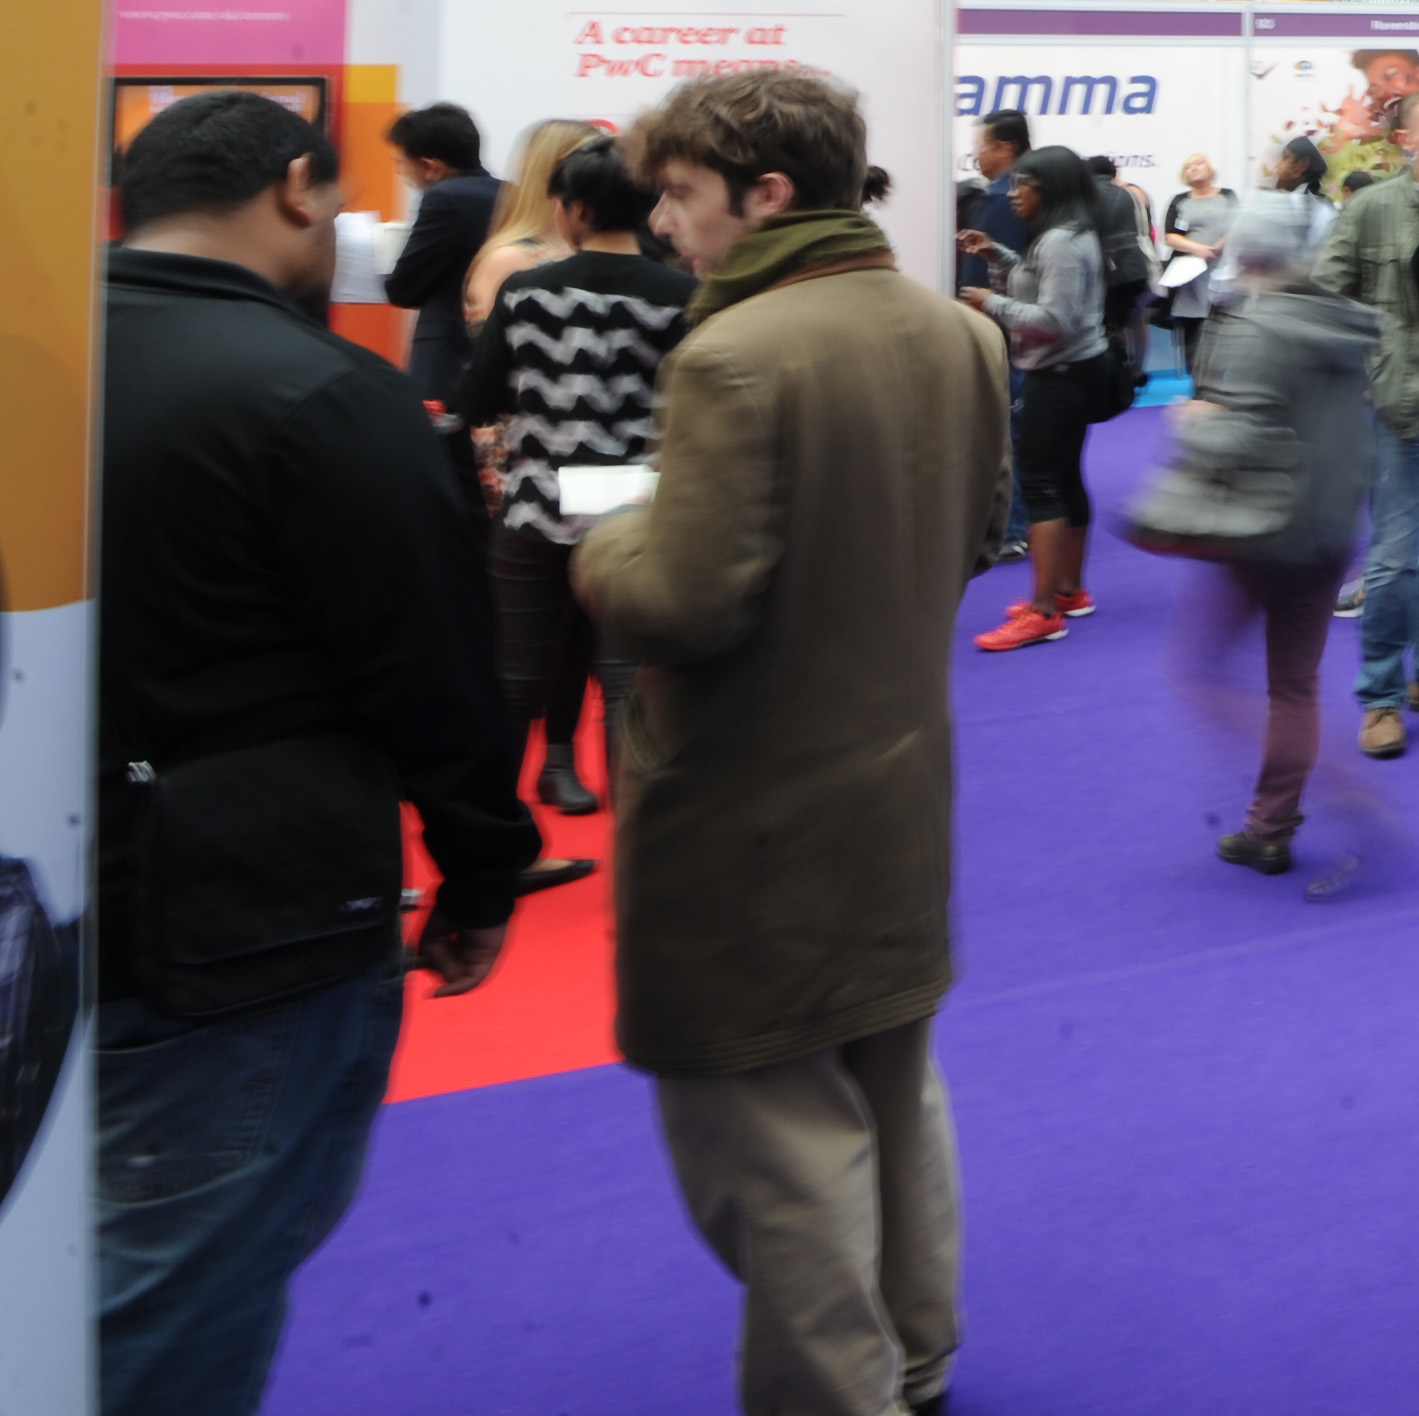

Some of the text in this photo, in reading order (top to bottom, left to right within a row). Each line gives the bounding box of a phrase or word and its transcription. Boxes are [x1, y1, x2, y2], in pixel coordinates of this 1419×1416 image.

[574, 20, 787, 45] A career at
[573, 52, 667, 78] PwC
